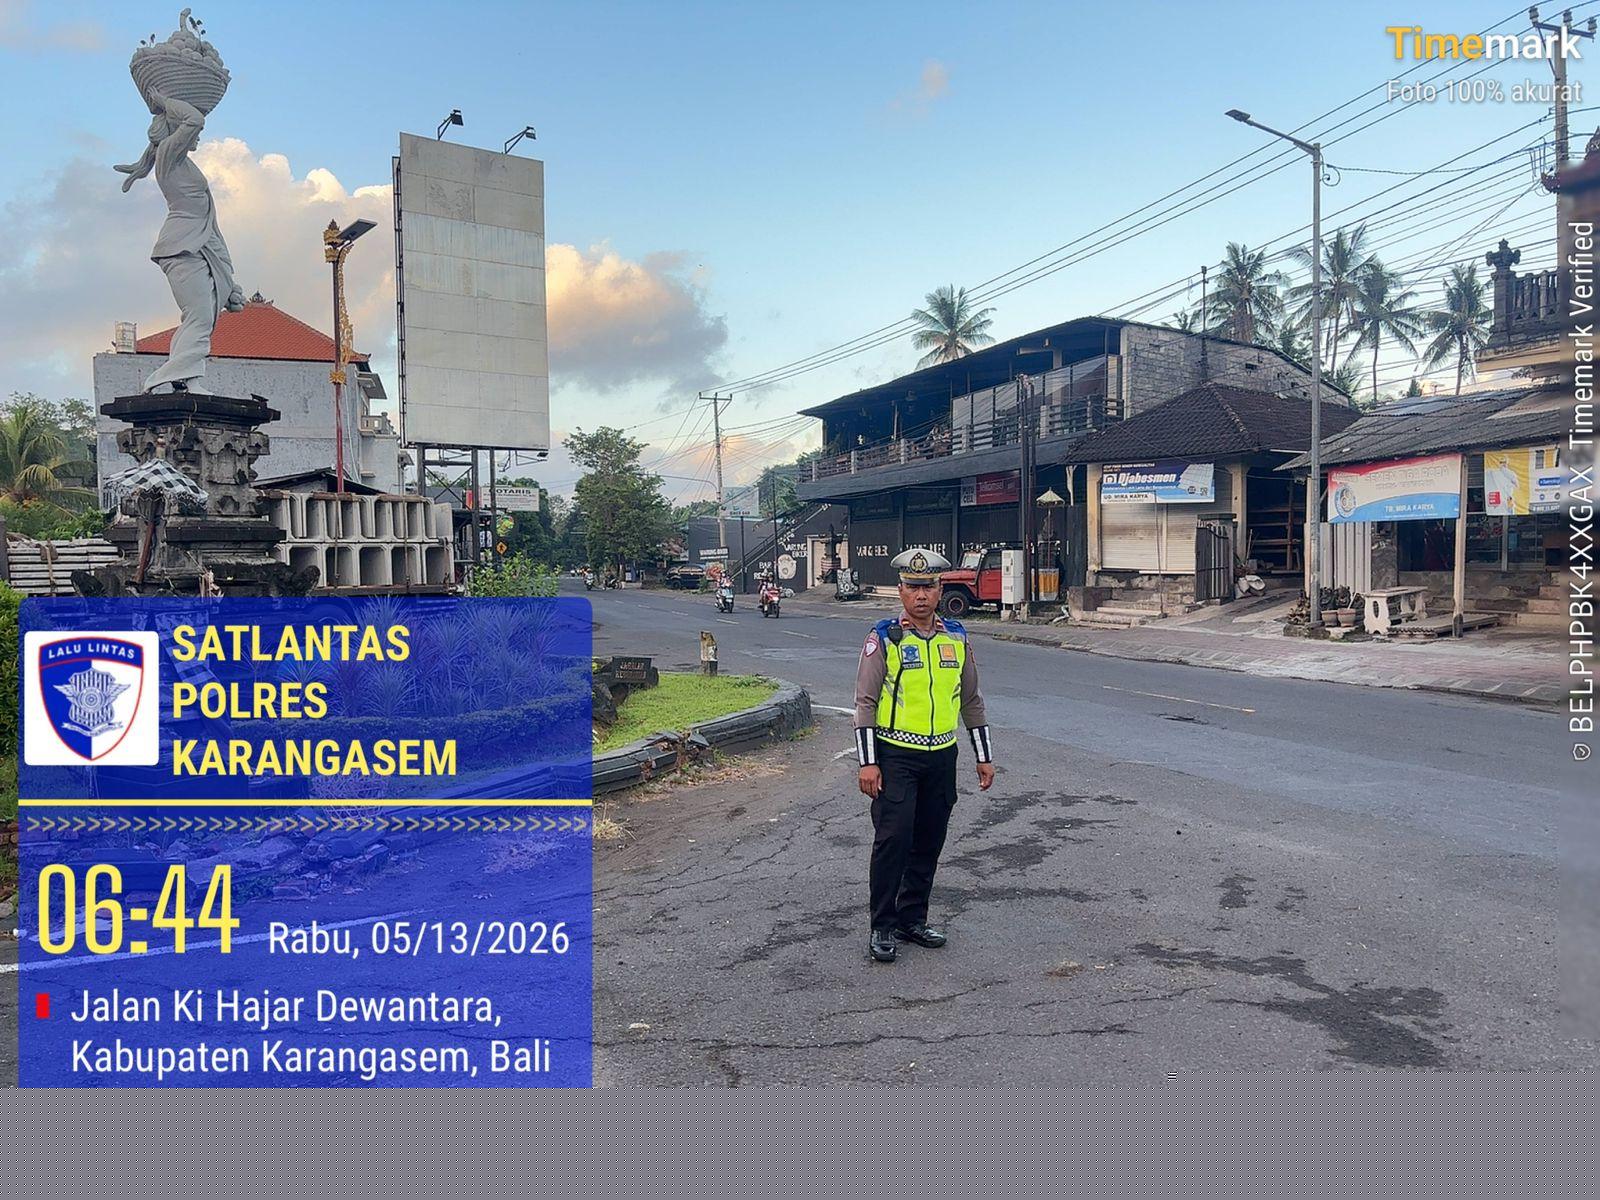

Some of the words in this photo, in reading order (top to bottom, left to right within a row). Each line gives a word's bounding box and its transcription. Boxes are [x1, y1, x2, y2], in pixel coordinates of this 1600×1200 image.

[1118, 473, 1176, 486] Djabesmen
[489, 487, 531, 495] OTARIS
[1412, 503, 1435, 511] KARYA
